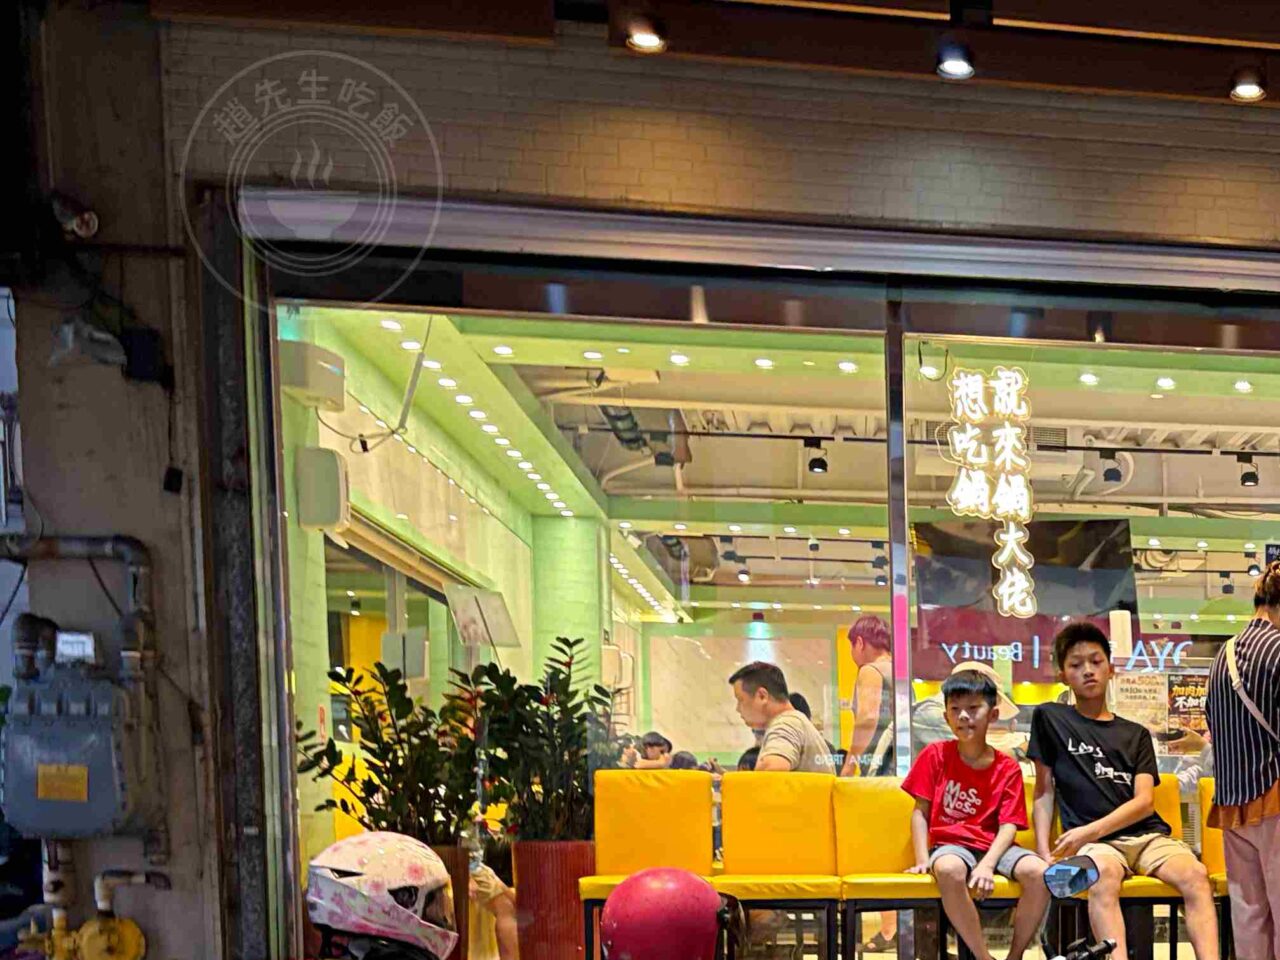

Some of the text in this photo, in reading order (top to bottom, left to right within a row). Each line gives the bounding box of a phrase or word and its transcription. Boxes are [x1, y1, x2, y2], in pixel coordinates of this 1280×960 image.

[952, 371, 990, 514] 想吃鍋
[990, 368, 1034, 615] 就來鍋大佬
